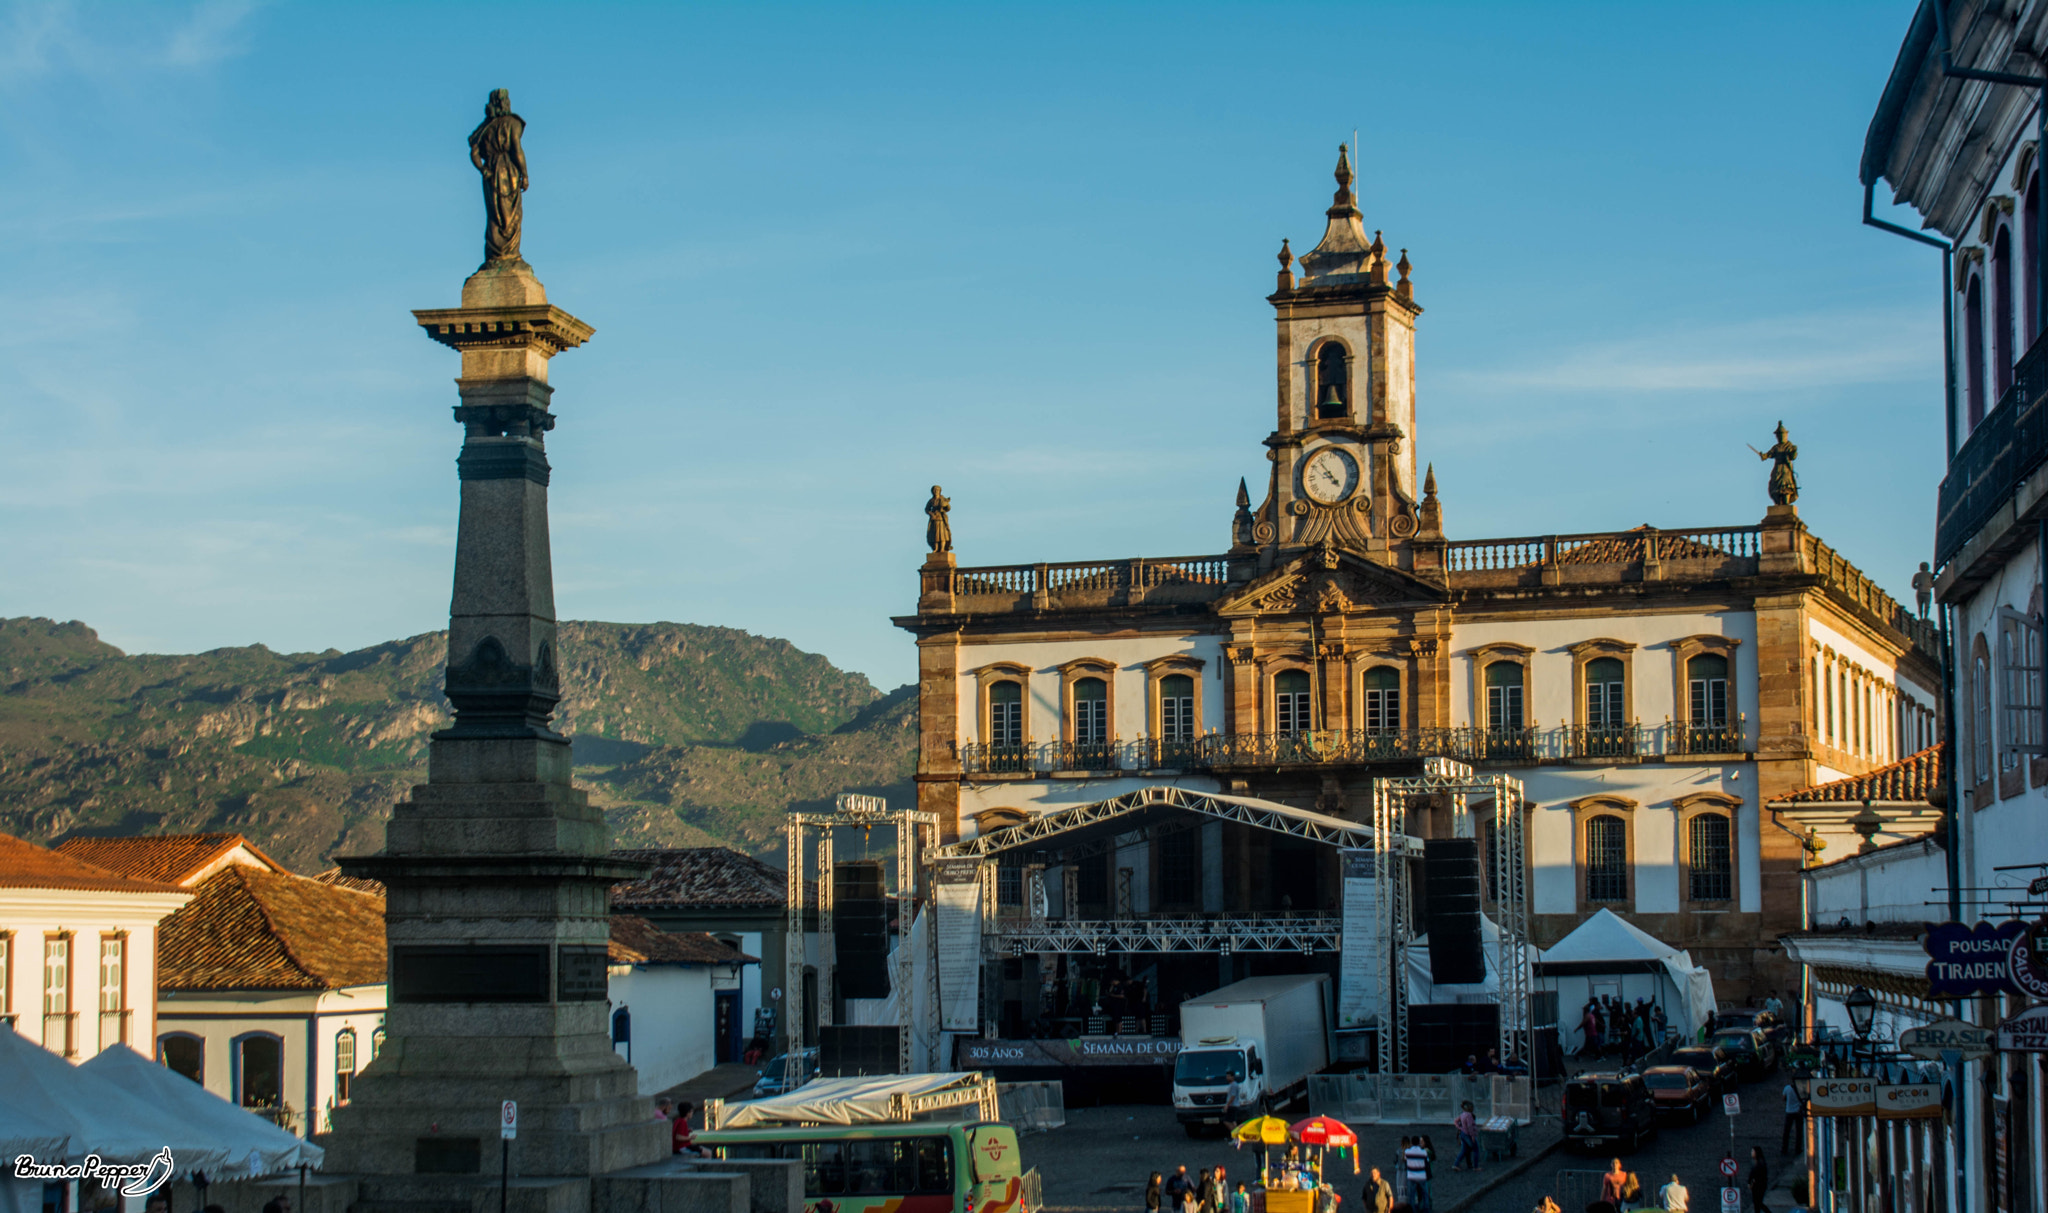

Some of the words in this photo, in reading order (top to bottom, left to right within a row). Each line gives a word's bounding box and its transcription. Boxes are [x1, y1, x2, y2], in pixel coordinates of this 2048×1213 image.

[2034, 879, 2048, 892] RE
[1933, 961, 2007, 980] TIRADEN
[2014, 946, 2048, 995] CALDOS
[1915, 1029, 1986, 1044] BRASIL
[2013, 1035, 2048, 1048] PIZZ
[969, 1047, 989, 1058] 305
[991, 1047, 1024, 1058] ANOS
[1083, 1041, 1134, 1055] SEMANA
[1137, 1041, 1153, 1054] DE
[1817, 1081, 1872, 1097] decora
[1888, 1088, 1929, 1101] decora
[1832, 1094, 1873, 1102] brasil
